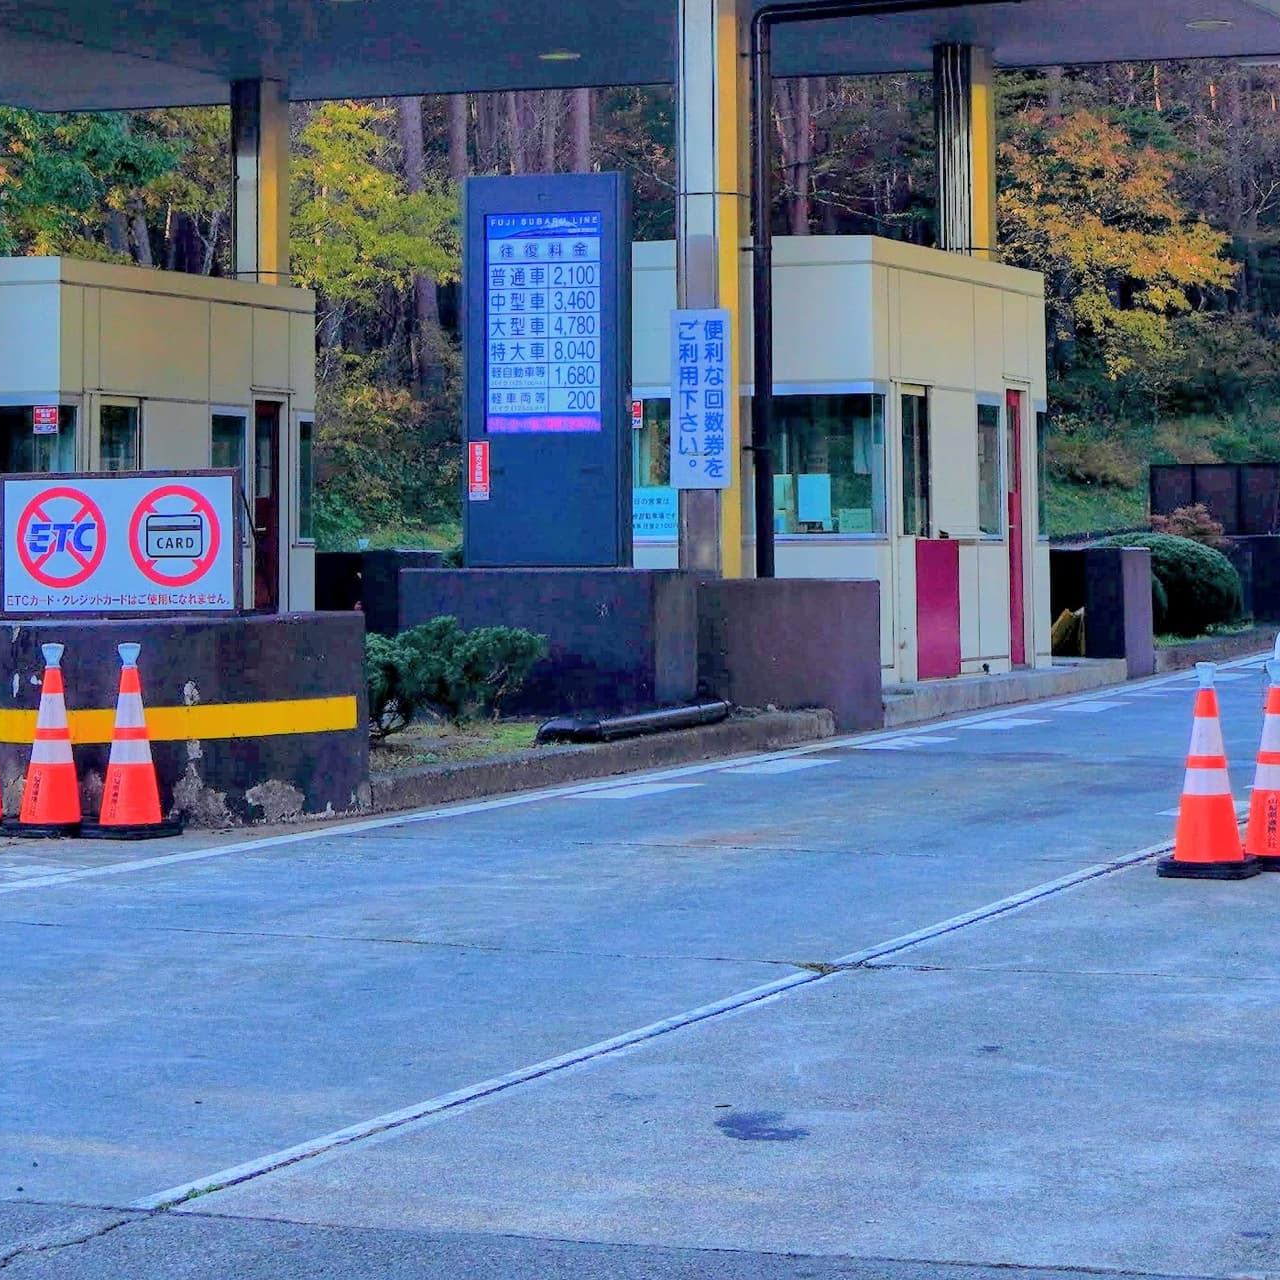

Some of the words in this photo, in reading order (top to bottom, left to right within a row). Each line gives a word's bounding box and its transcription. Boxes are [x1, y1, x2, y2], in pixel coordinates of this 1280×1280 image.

[490, 218, 516, 227] FUJI
[573, 216, 598, 225] LINE
[500, 241, 588, 258] 往復料金
[490, 266, 545, 287] 普通車
[554, 265, 595, 287] 2,100
[490, 292, 545, 312] 中型車
[554, 290, 595, 312] 3,460
[490, 317, 545, 337] 大型車
[554, 315, 595, 336] 4,780
[490, 342, 545, 361] 特大車
[554, 340, 595, 361] 8,040
[555, 365, 595, 387] 1,680
[567, 390, 595, 410] 200
[678, 319, 699, 469] ご利用下さい。
[703, 319, 724, 479] 便利な回数券を
[27, 522, 96, 553] ETC
[156, 537, 195, 550] CARD
